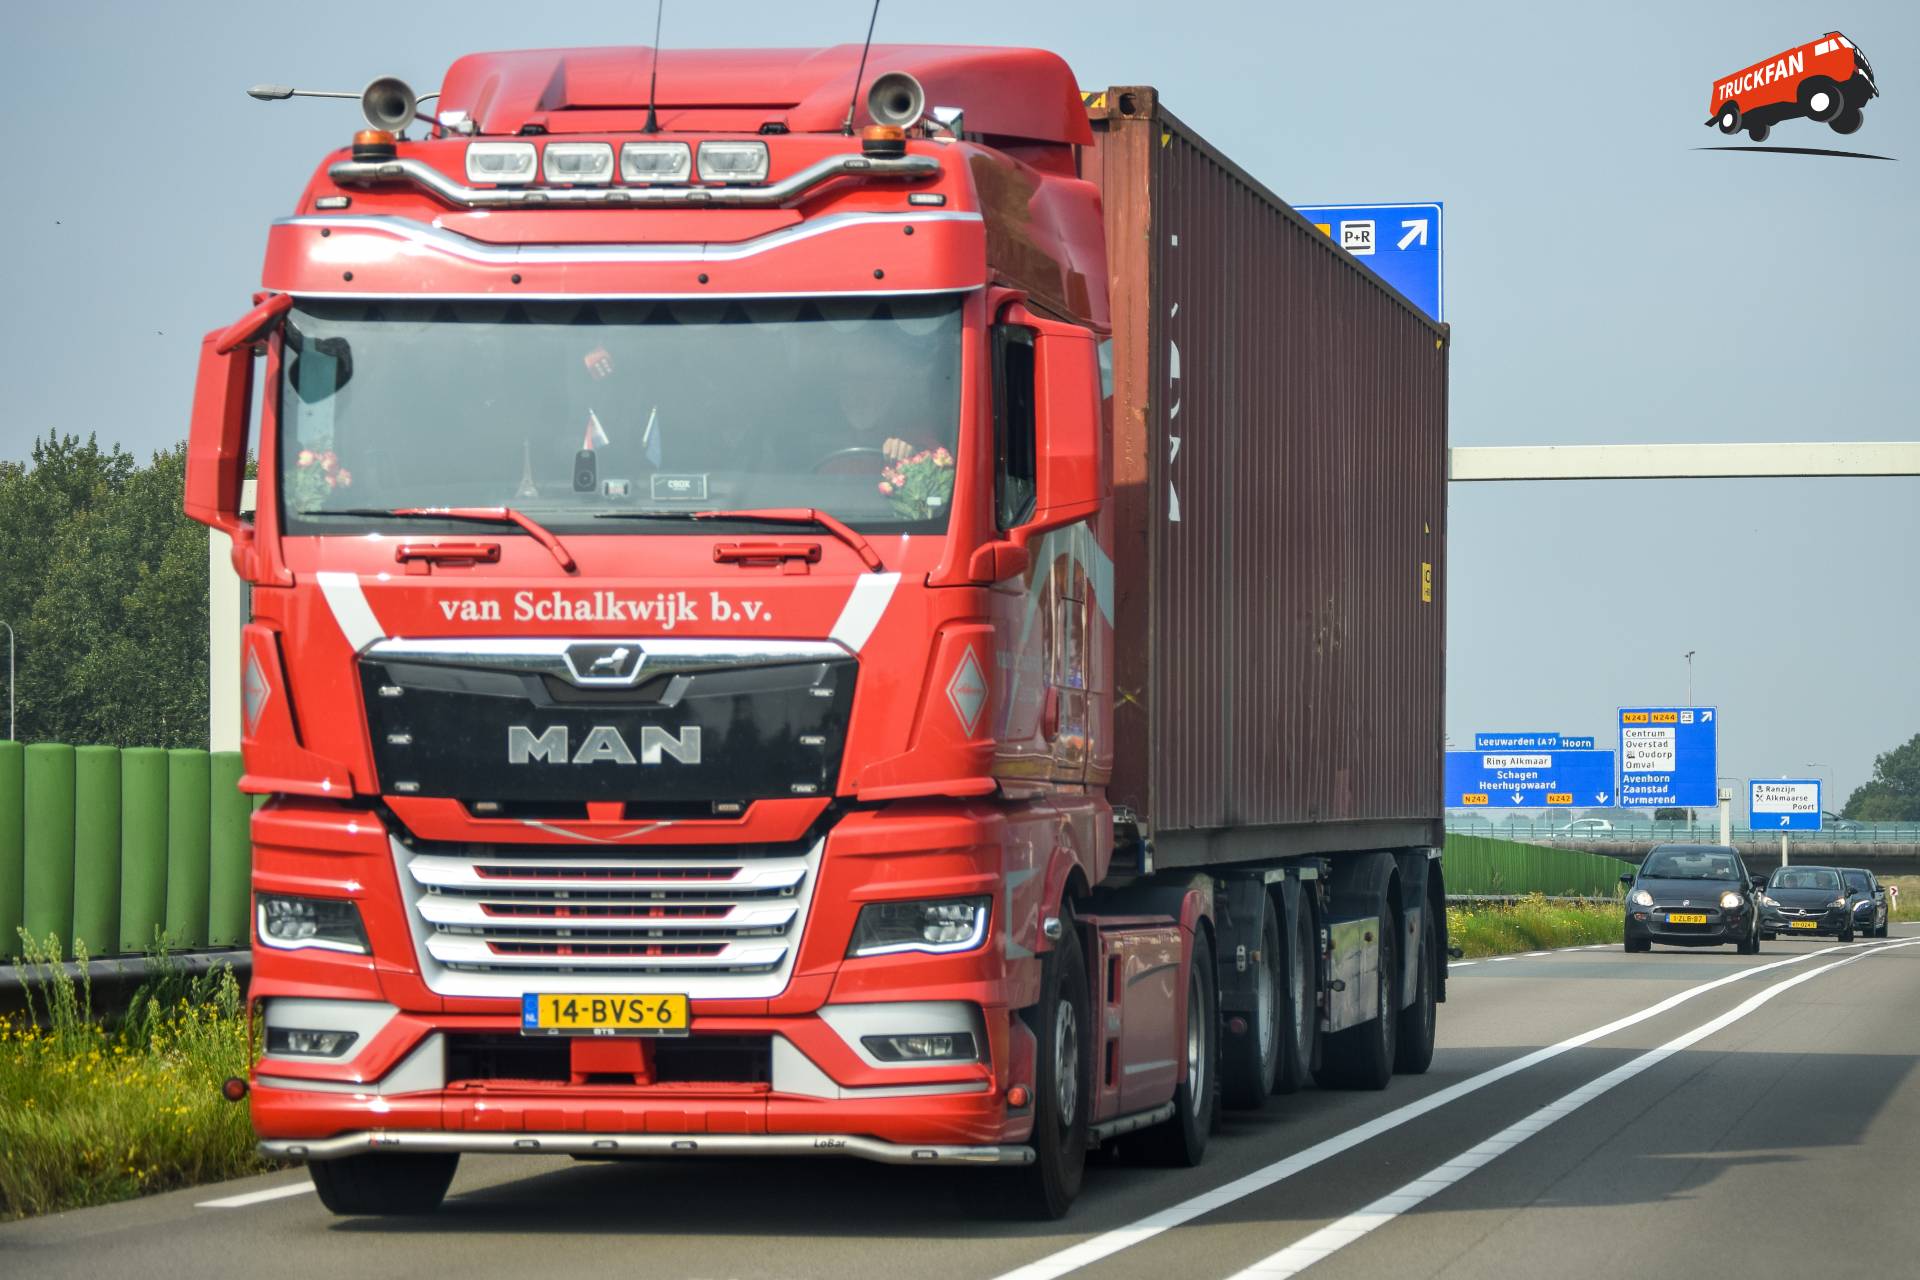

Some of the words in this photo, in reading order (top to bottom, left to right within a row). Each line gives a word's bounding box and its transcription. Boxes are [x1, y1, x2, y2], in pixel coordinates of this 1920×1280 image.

[1344, 230, 1370, 243] P+R
[439, 597, 501, 622] van
[513, 591, 699, 631] Schalkwijk
[710, 594, 773, 623] b.v.
[507, 725, 702, 766] MAN
[1478, 737, 1535, 746] Leeuwarden
[1562, 739, 1592, 748] Hoorn
[1625, 740, 1668, 748] Overstad
[1638, 750, 1673, 759] Oudorp
[1486, 758, 1507, 767] Ring
[1510, 757, 1549, 765] Alkmaar
[1625, 761, 1655, 769] Omval
[1497, 770, 1538, 780] Schagen
[1623, 774, 1670, 783] Avenhorn
[1479, 781, 1557, 791] Heerhugowaard
[1623, 784, 1668, 793] Zaanstad
[1765, 785, 1796, 794] Ranzijn
[1464, 795, 1487, 803] N242
[1548, 794, 1571, 802] N242
[1623, 795, 1676, 804] Purmerend
[552, 999, 673, 1024] 14-BVS-6
[525, 1013, 537, 1022] NL
[814, 1137, 847, 1147] LoBar
